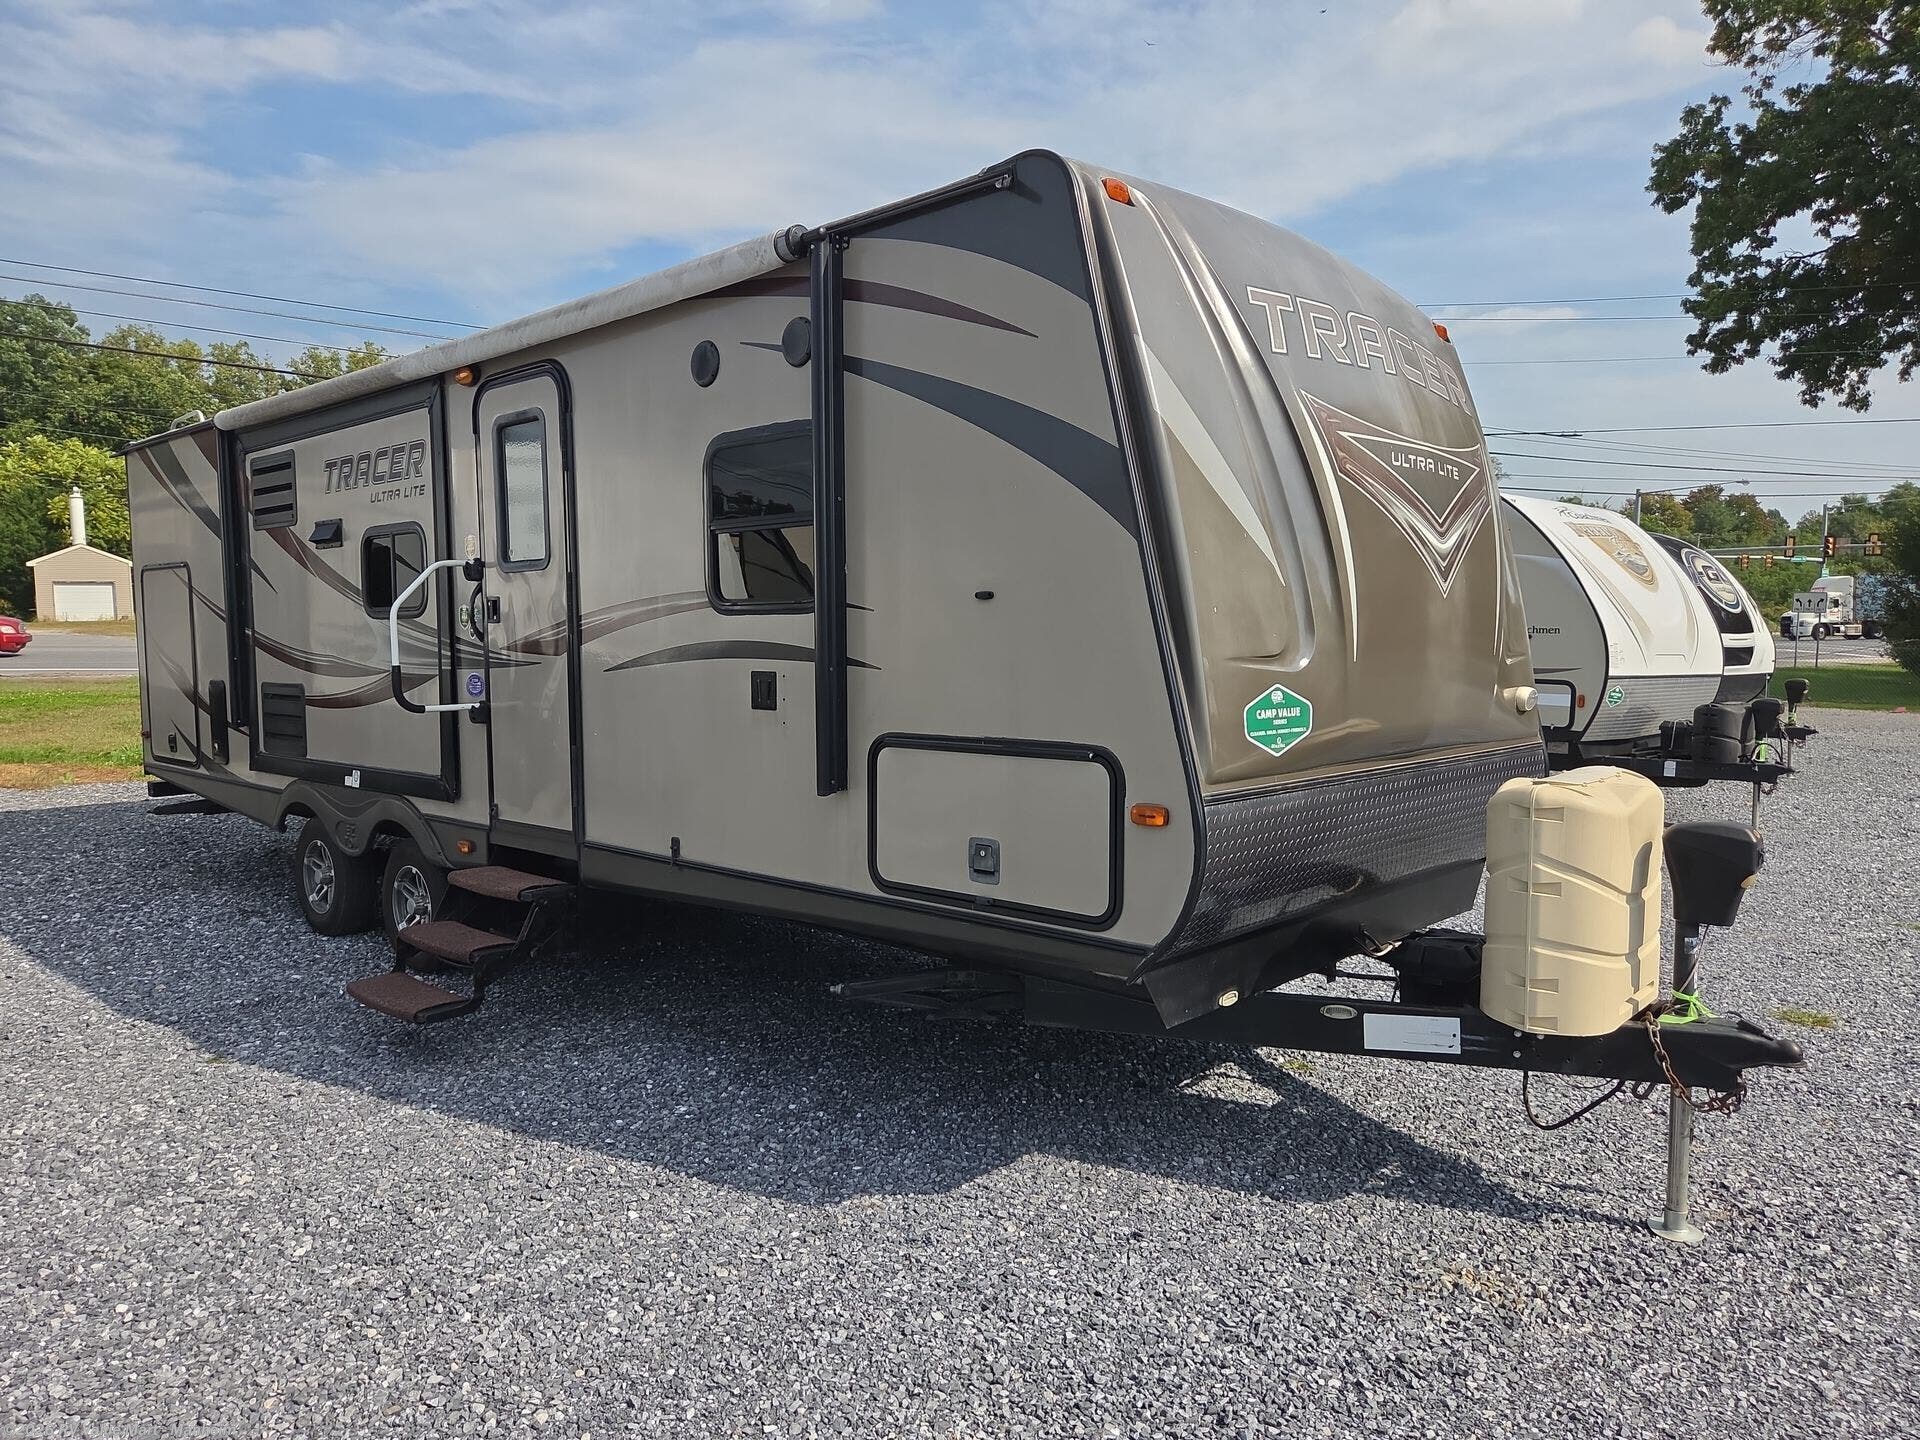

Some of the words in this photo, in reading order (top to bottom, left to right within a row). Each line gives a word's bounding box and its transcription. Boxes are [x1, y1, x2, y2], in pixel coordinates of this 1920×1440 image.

[1246, 285, 1473, 417] TRACER
[323, 438, 426, 495] TRACER
[1391, 451, 1435, 473] ULTRA
[1437, 461, 1460, 481] LITE
[370, 488, 401, 504] ULTRA
[403, 484, 426, 499] LITE
[1527, 625, 1561, 635] chmen
[1256, 709, 1277, 719] CAMP
[1277, 706, 1301, 717] VALUE
